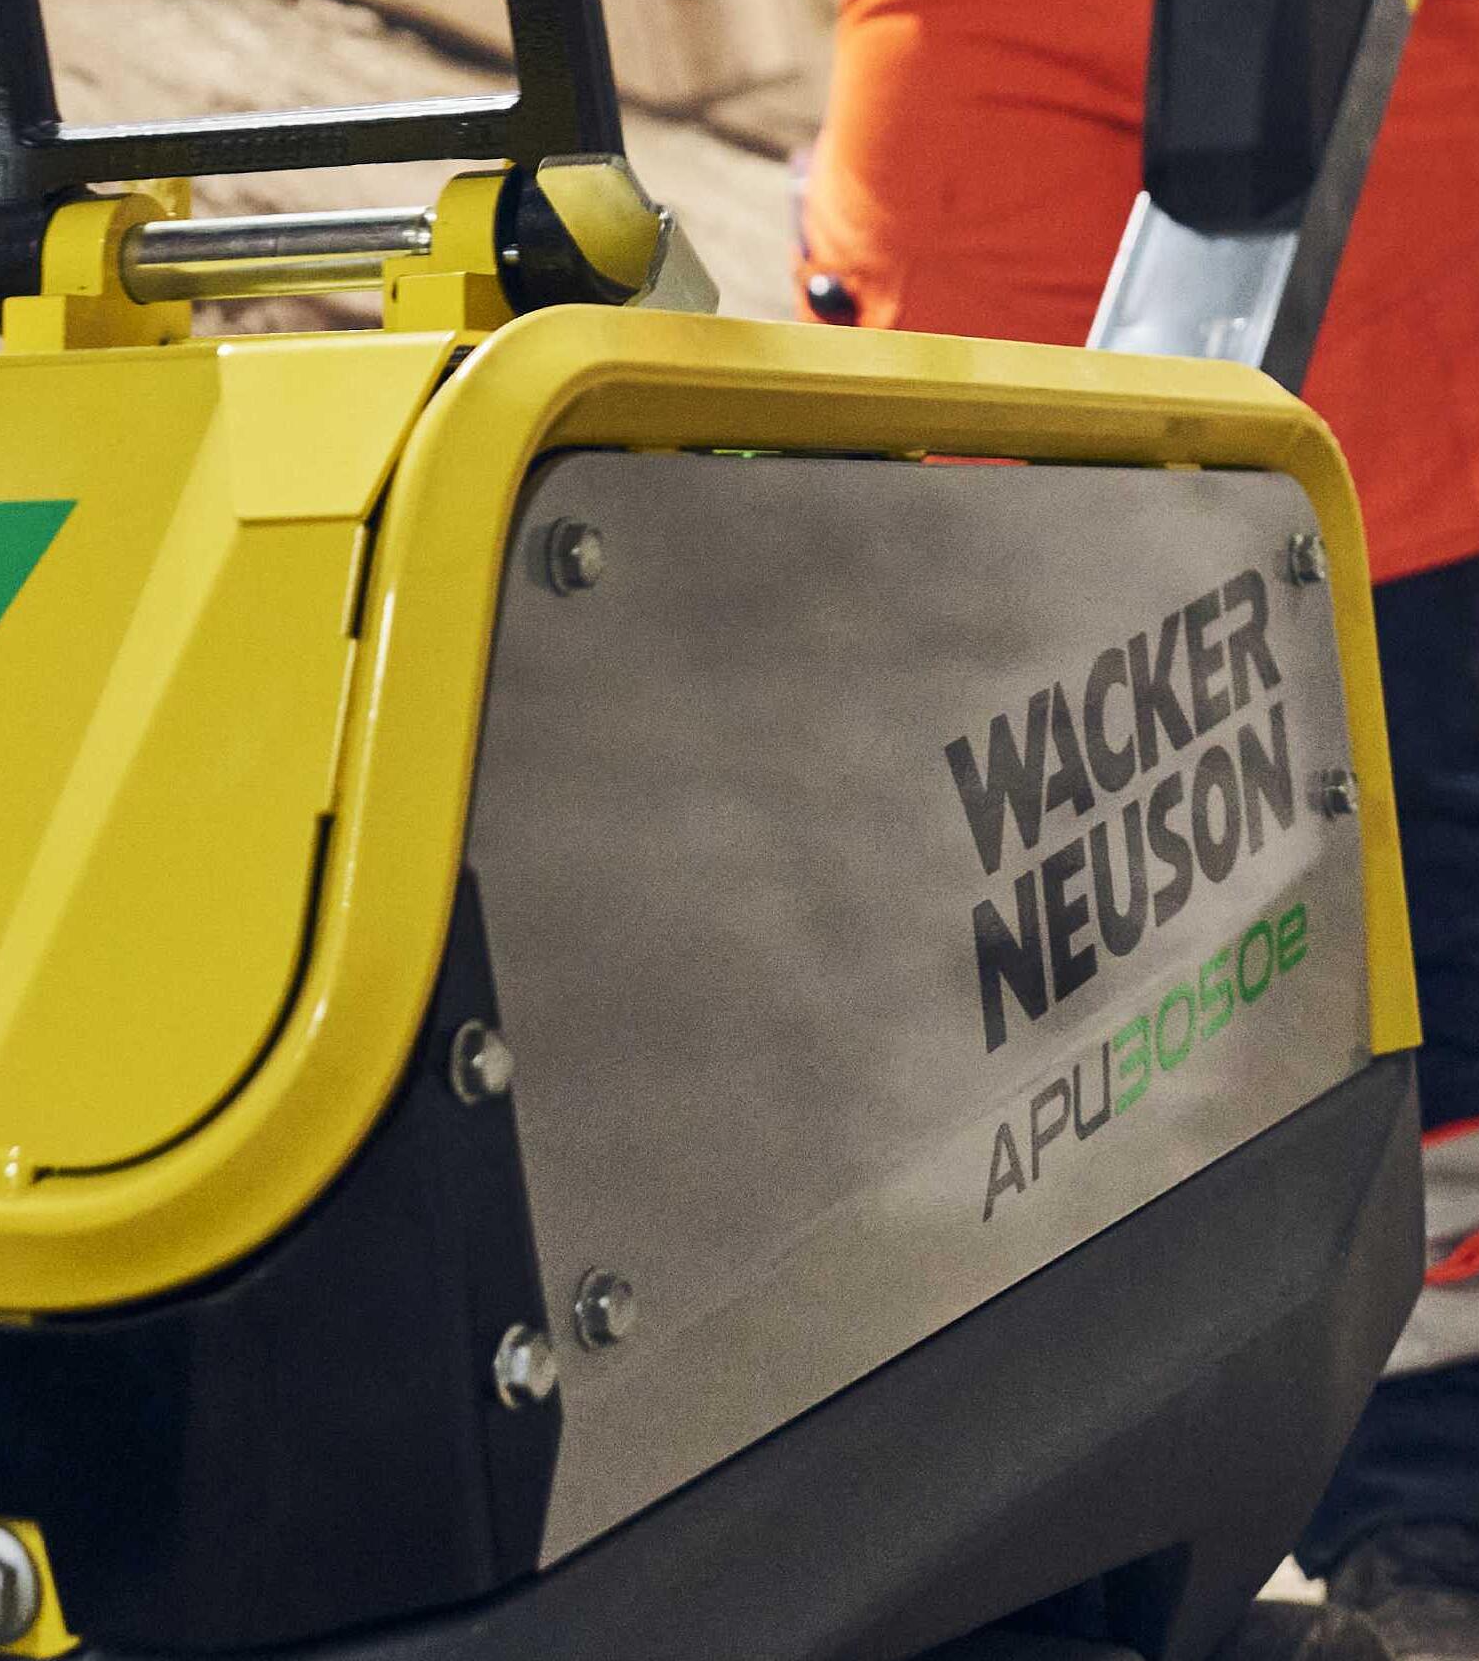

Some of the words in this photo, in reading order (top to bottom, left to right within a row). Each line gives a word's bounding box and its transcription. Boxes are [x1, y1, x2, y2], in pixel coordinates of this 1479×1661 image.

[943, 567, 1283, 876] WACKER
[971, 702, 1297, 1054] NEUSON
[981, 900, 1309, 1223] APU3050e
